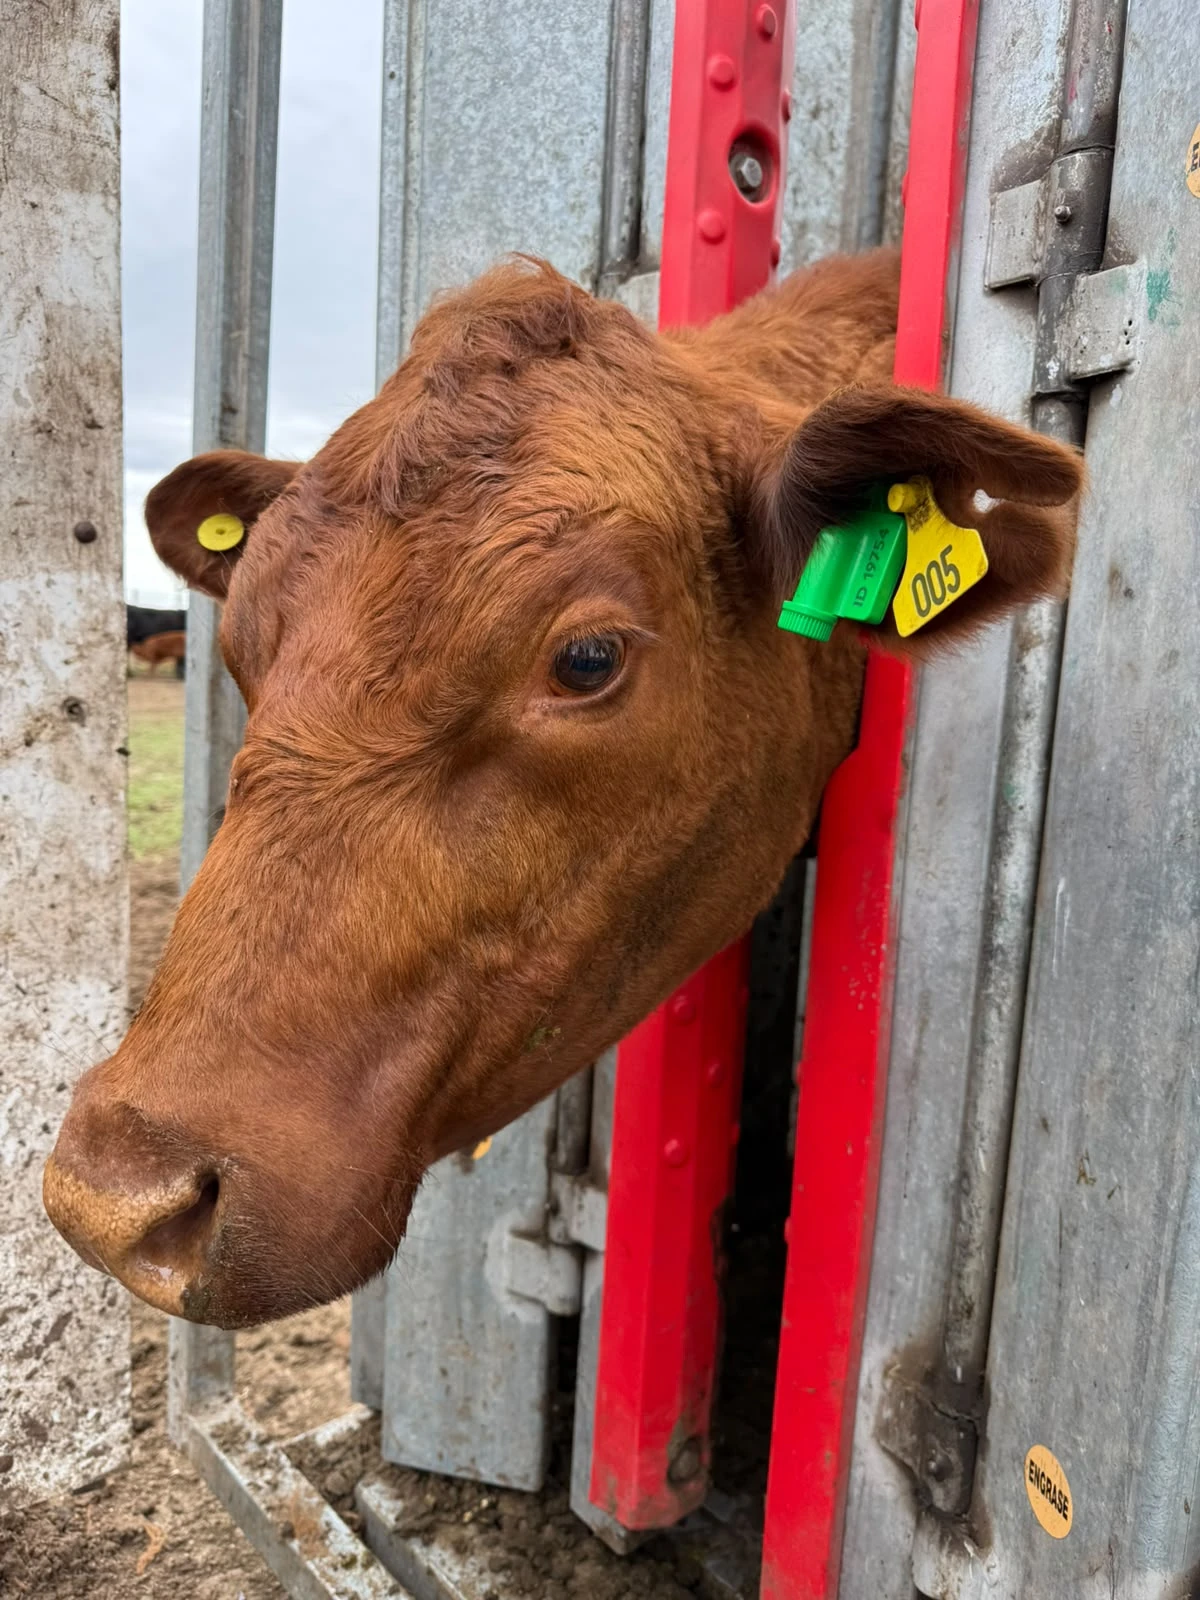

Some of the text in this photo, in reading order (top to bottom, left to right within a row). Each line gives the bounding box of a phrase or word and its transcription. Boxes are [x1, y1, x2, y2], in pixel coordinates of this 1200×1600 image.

[853, 528, 890, 607] ID 19754
[911, 545, 961, 618] 005
[1028, 1459, 1069, 1521] ENGRASE
